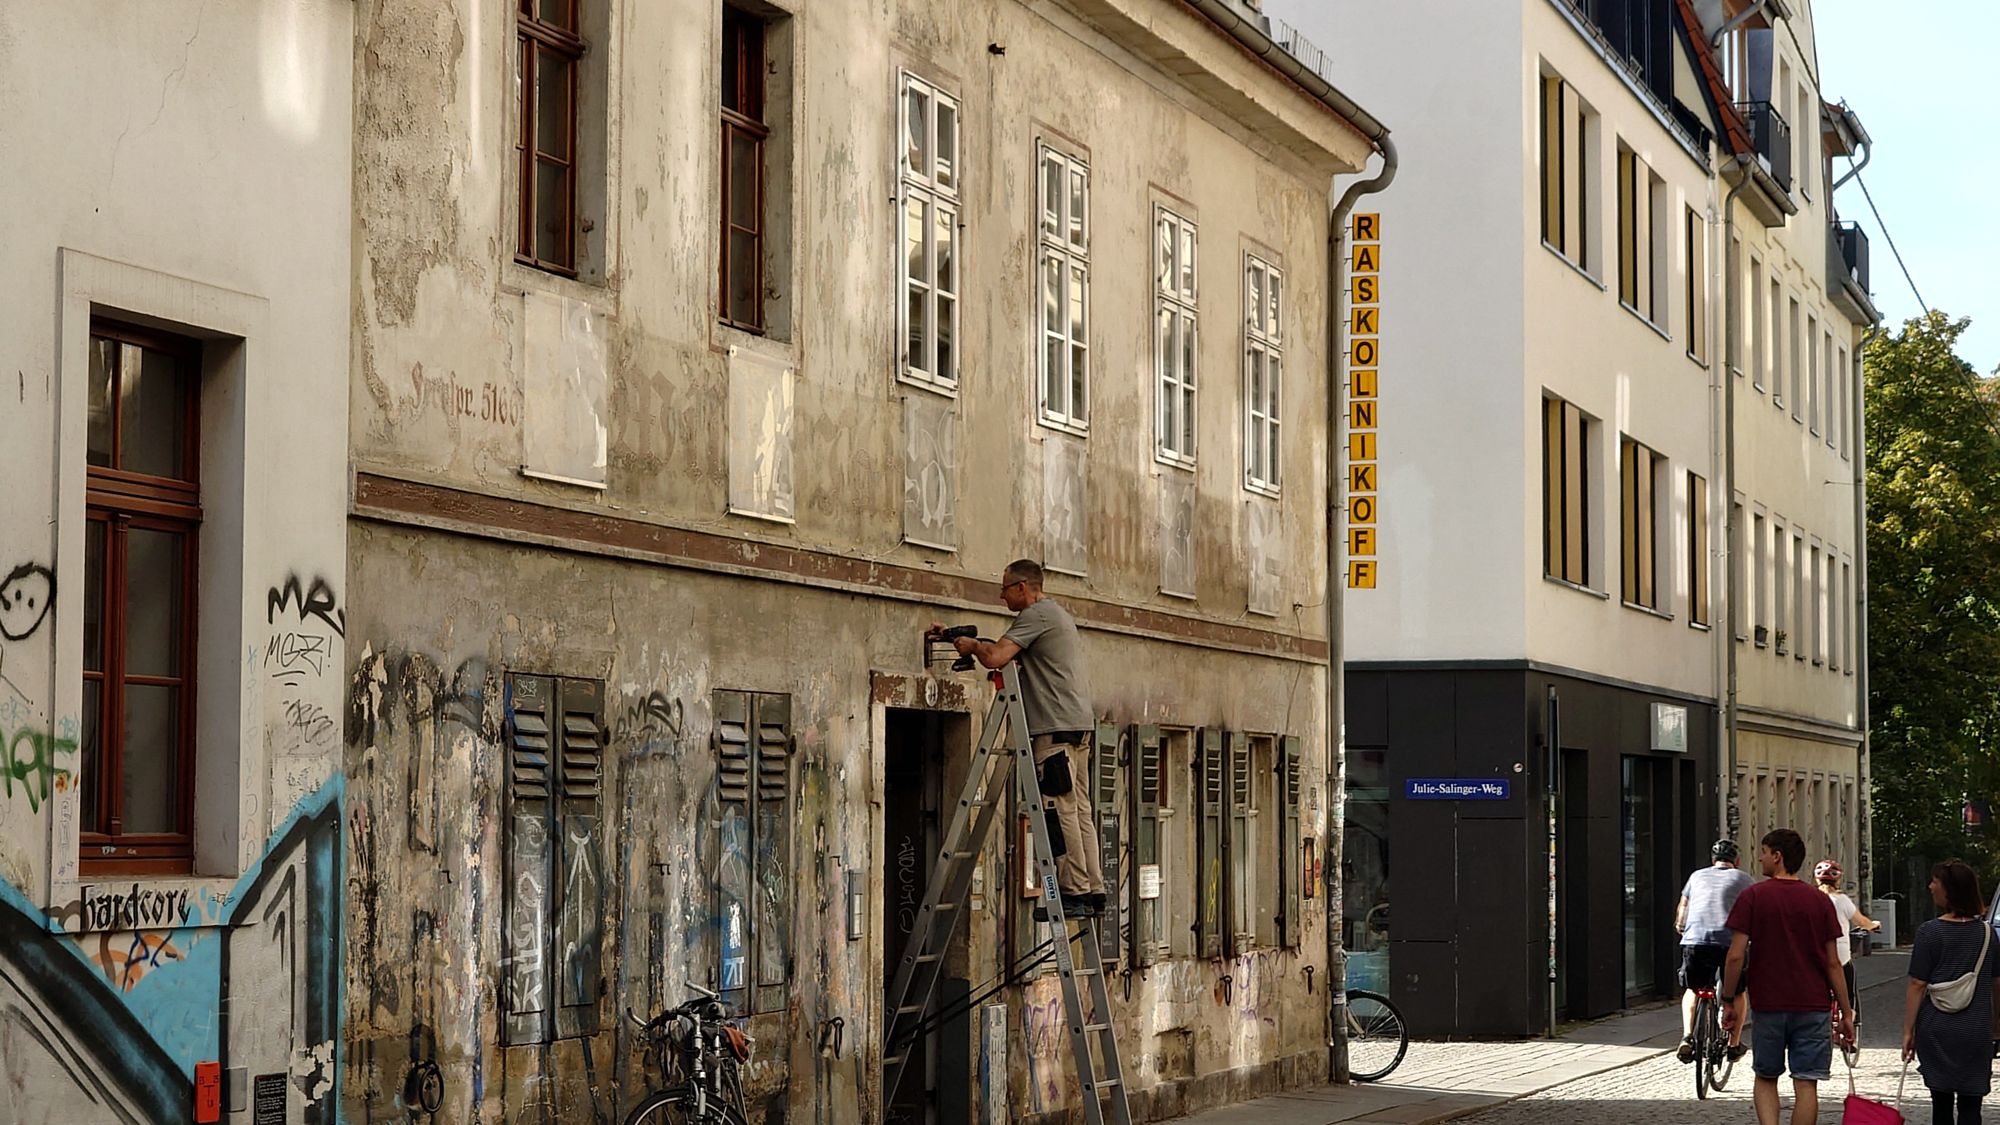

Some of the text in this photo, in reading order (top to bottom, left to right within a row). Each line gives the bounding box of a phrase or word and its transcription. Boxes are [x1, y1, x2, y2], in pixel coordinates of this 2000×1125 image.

[1354, 215, 1376, 586] RASKOLNIKOFF
[1412, 783, 1503, 796] Julie-Salinger-Weg
[81, 883, 191, 932] hardcore
